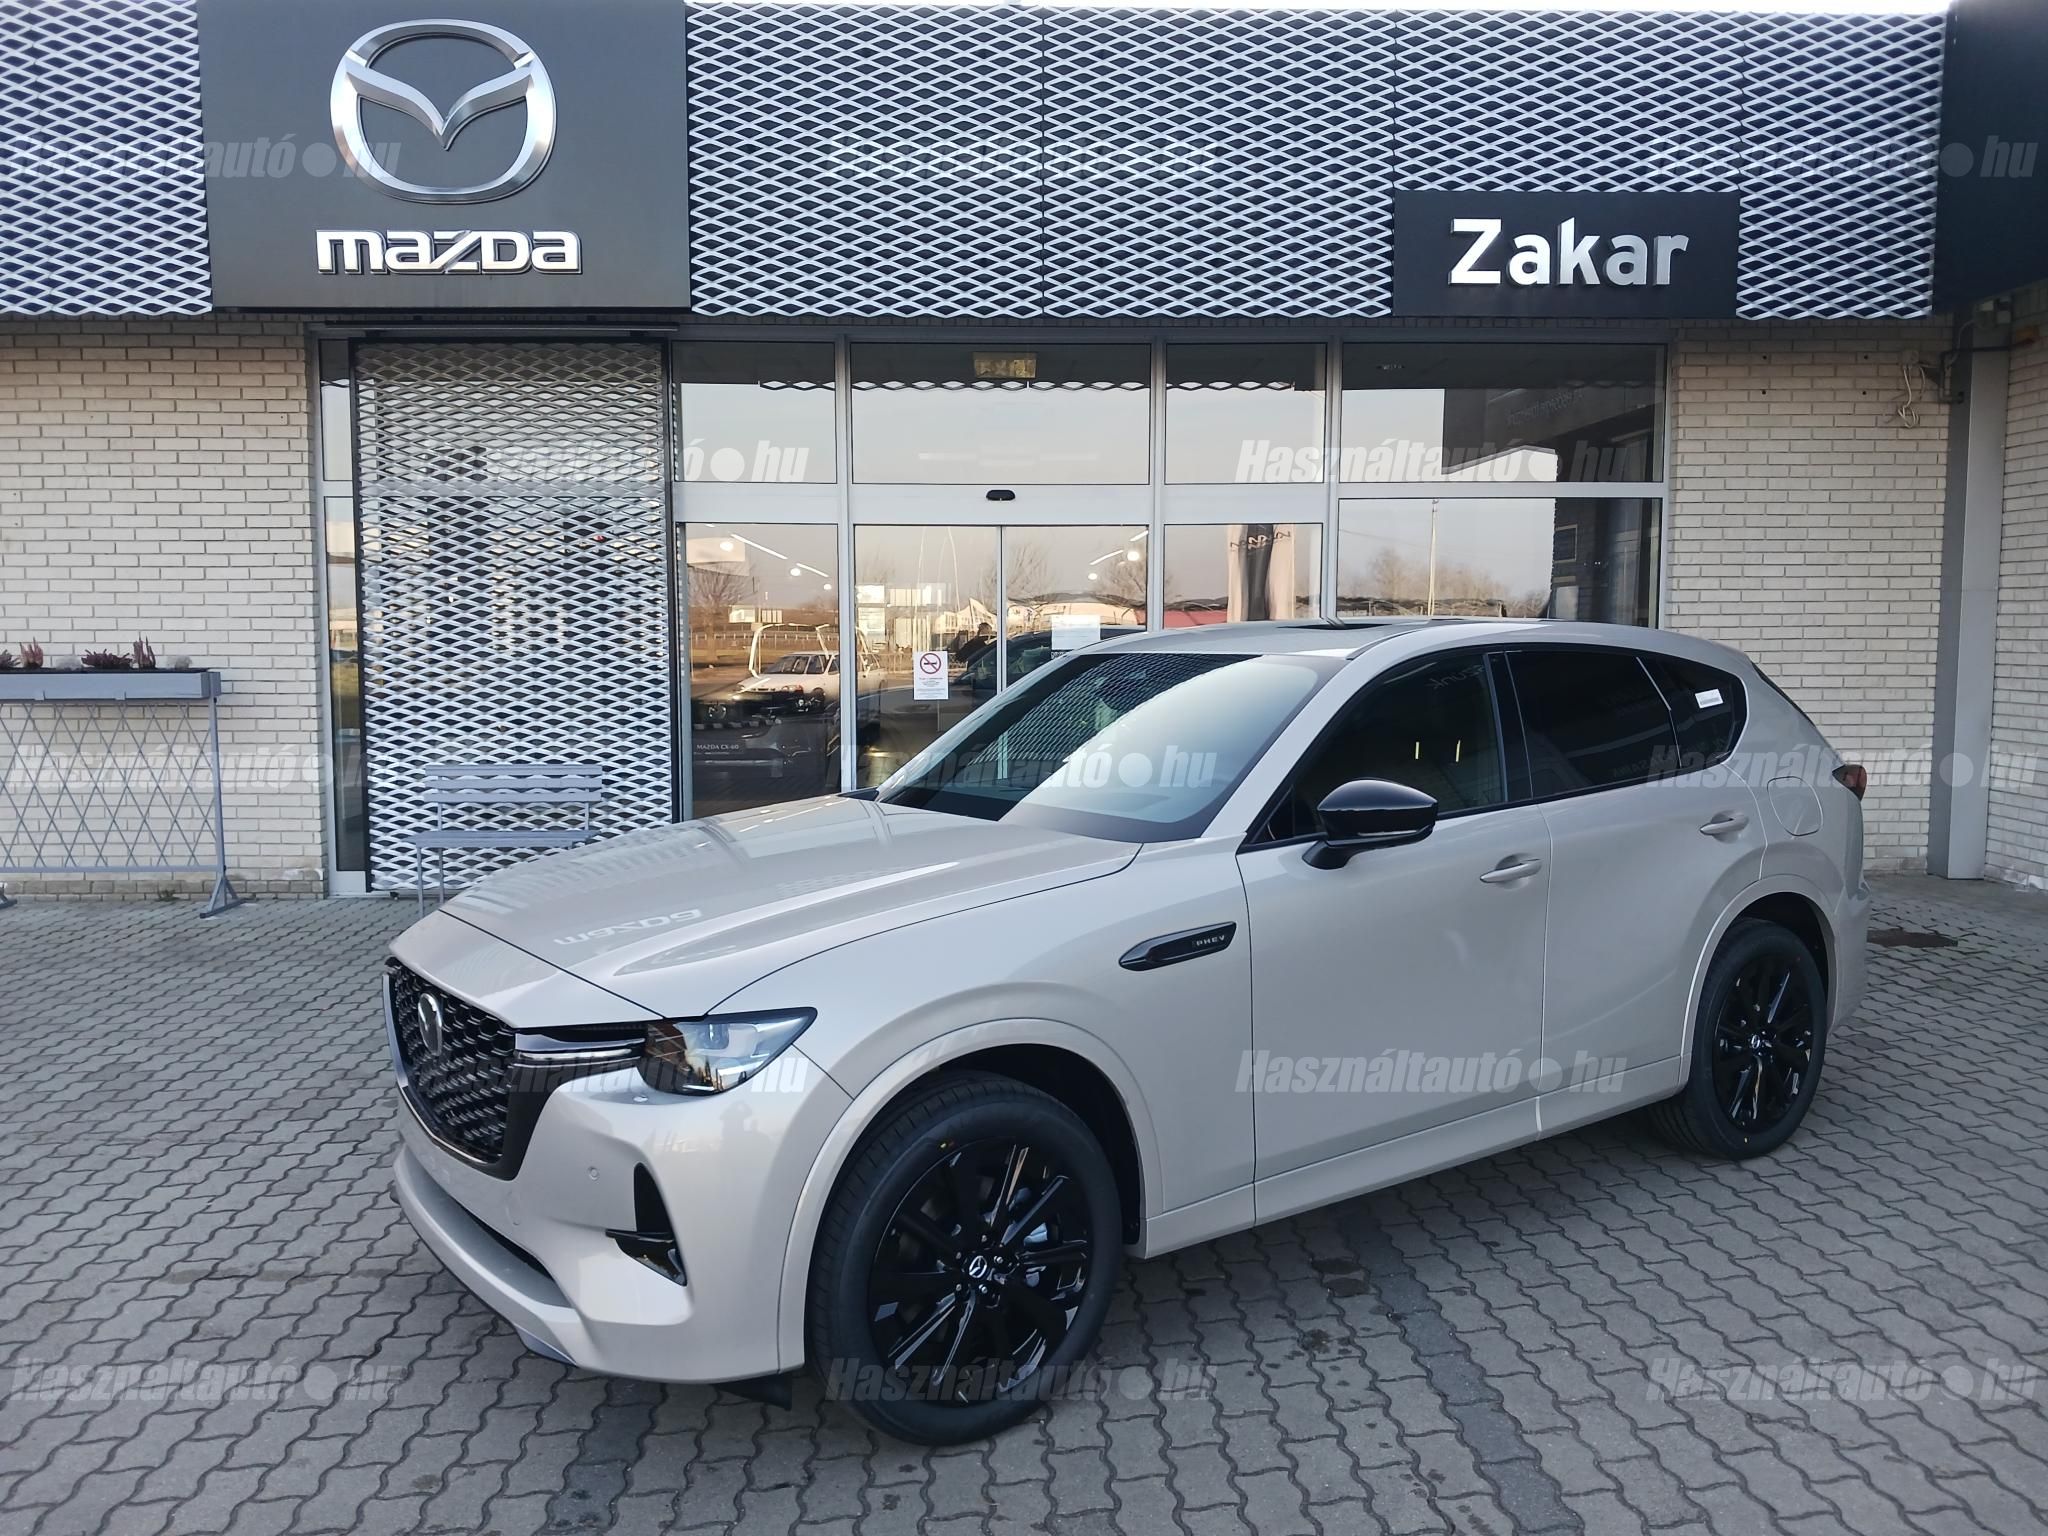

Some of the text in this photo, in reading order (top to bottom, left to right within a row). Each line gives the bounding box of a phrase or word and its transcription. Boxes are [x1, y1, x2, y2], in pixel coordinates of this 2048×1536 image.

[316, 229, 582, 275] mazda
[1448, 217, 1690, 286] Zakar
[1195, 934, 1226, 947] PHEV
